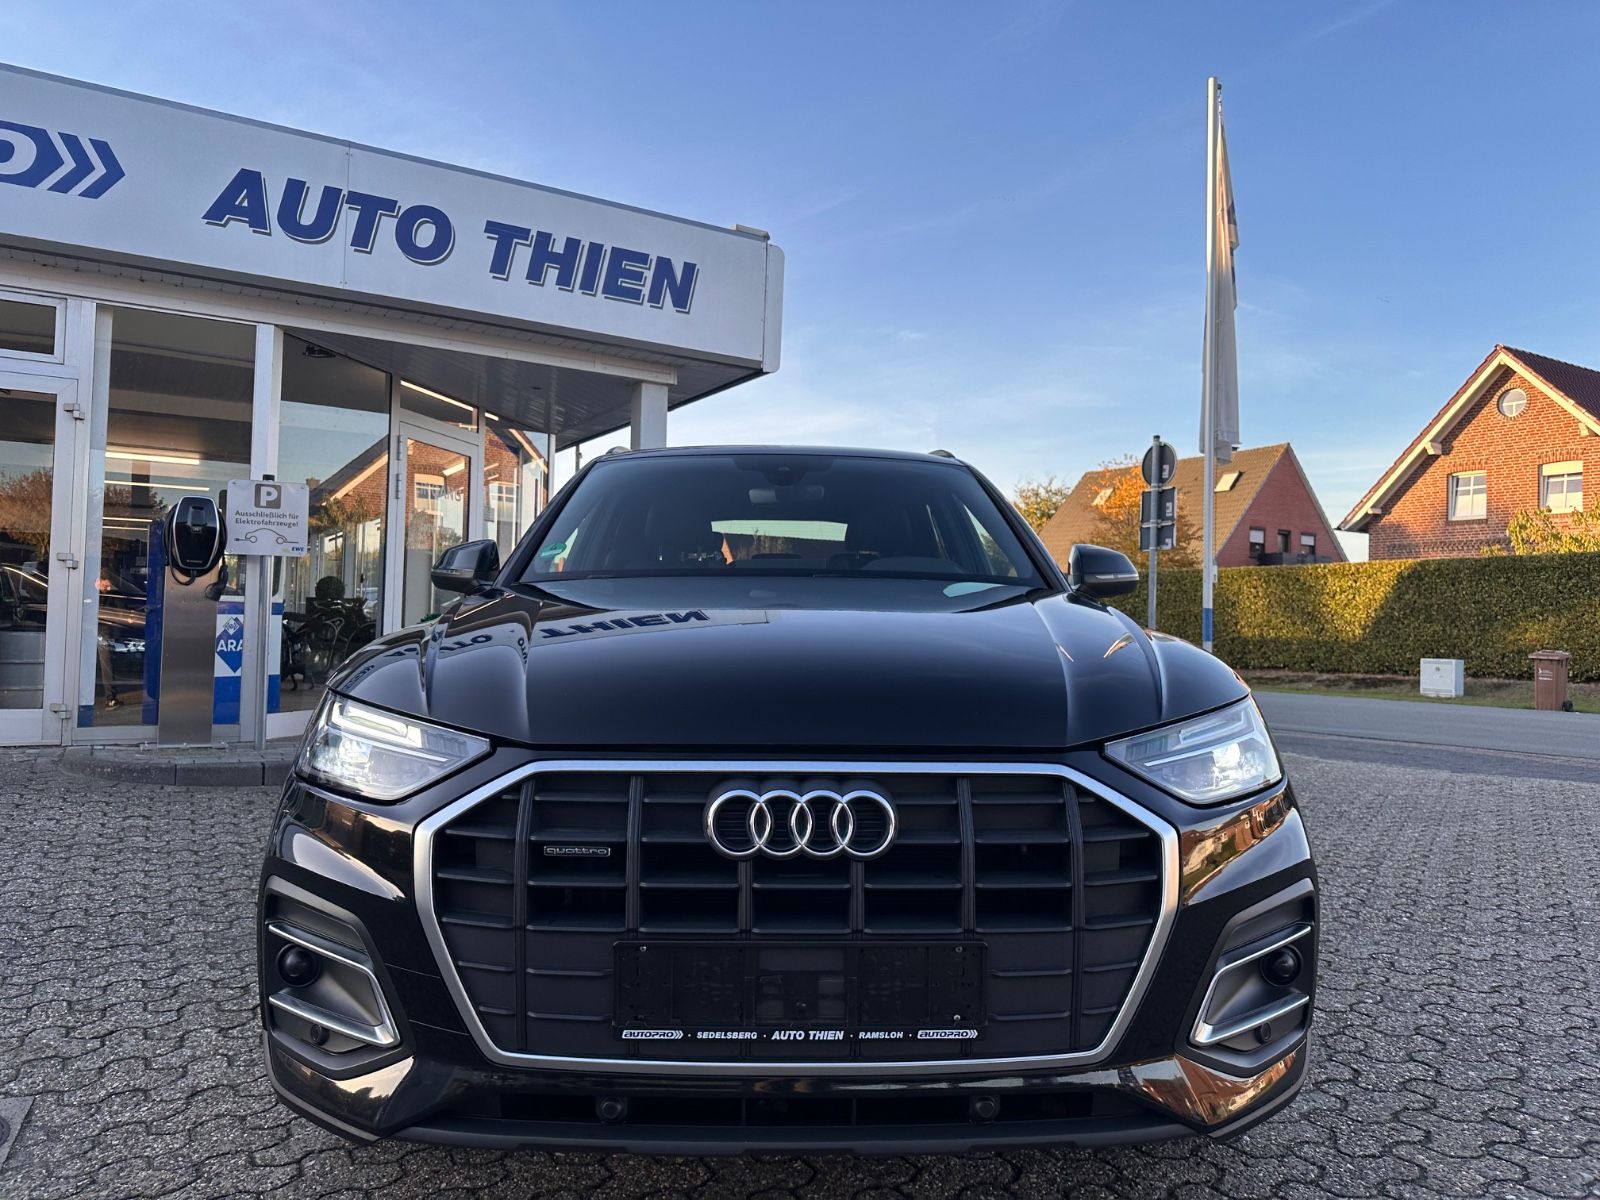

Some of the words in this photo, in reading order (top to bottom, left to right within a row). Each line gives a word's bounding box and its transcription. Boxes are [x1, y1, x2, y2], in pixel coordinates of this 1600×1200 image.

[201, 168, 456, 266] AUTO
[484, 220, 699, 314] THIEN
[260, 485, 279, 507] P
[235, 510, 287, 519] Ausschließlich
[546, 847, 608, 855] quattro
[697, 1031, 758, 1039] SEDELSBERG
[771, 1030, 805, 1040] AUTO
[808, 1030, 844, 1040] THIEN
[858, 1031, 904, 1039] RAMSLOH
